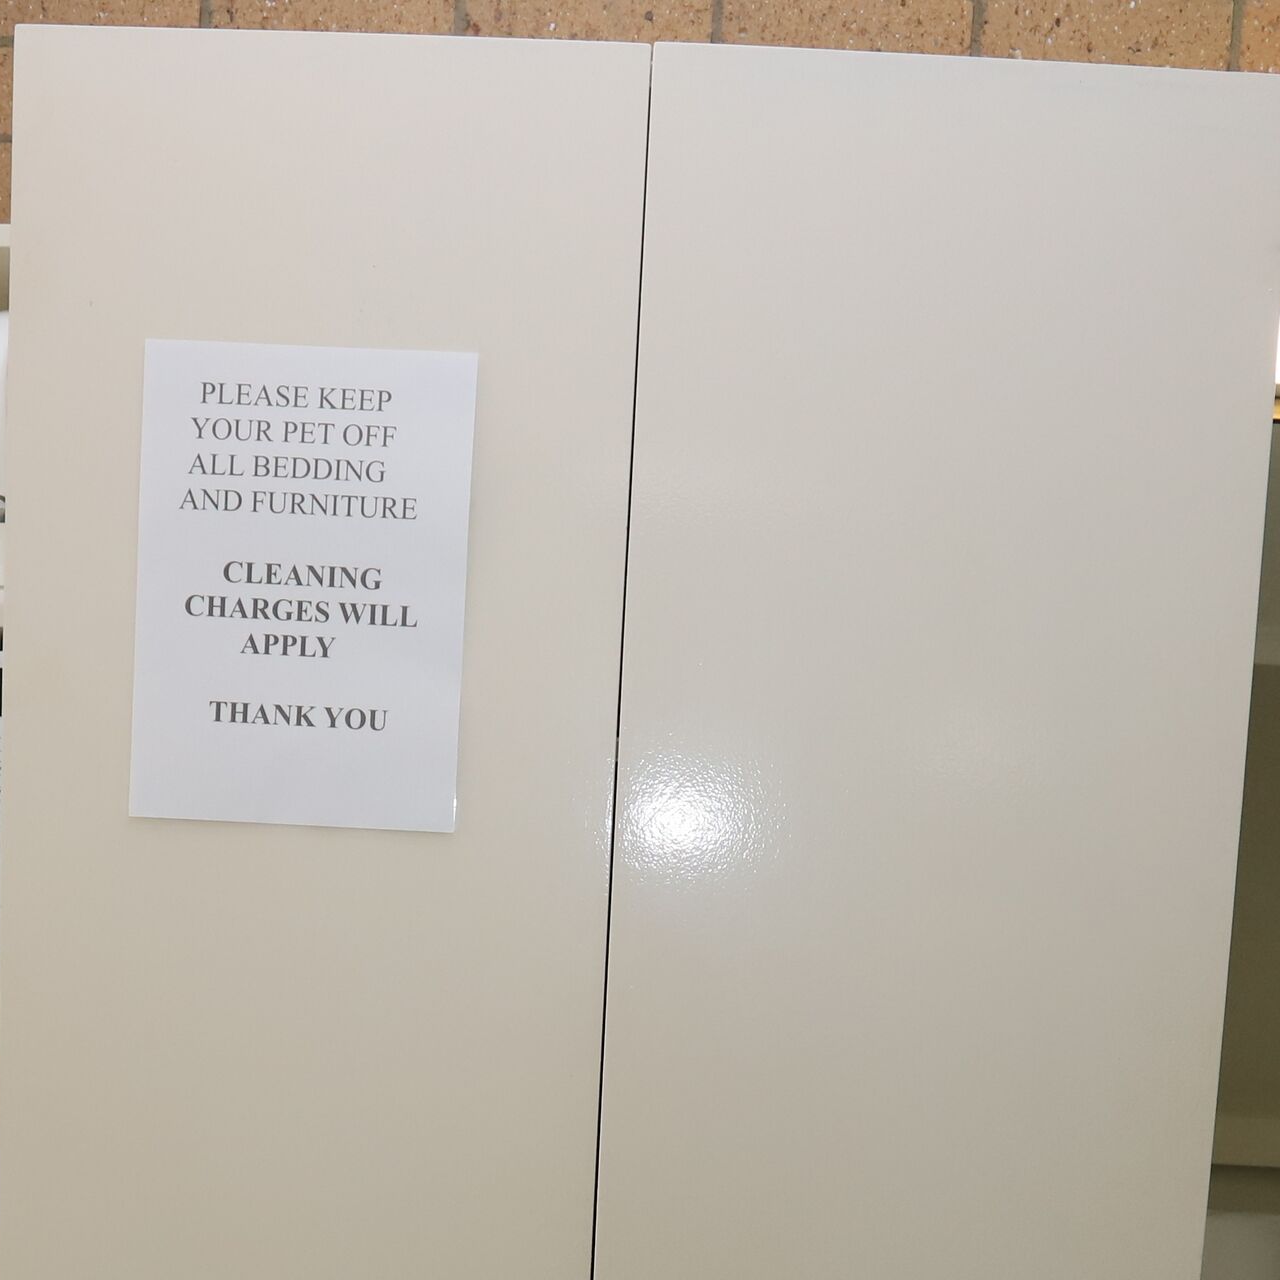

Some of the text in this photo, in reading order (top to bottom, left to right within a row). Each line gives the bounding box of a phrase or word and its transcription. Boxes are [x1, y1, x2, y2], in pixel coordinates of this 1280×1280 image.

[199, 381, 393, 413] PLEASE KEEP
[190, 416, 398, 448] YOUR PET OFF
[187, 452, 387, 484] ALL BEDDING
[178, 487, 418, 521] AND FURNITURE
[222, 560, 383, 591] CLEANING
[184, 594, 418, 628] CHARGES WILL
[239, 632, 337, 659] APPLY
[208, 700, 389, 732] THANK YOU
